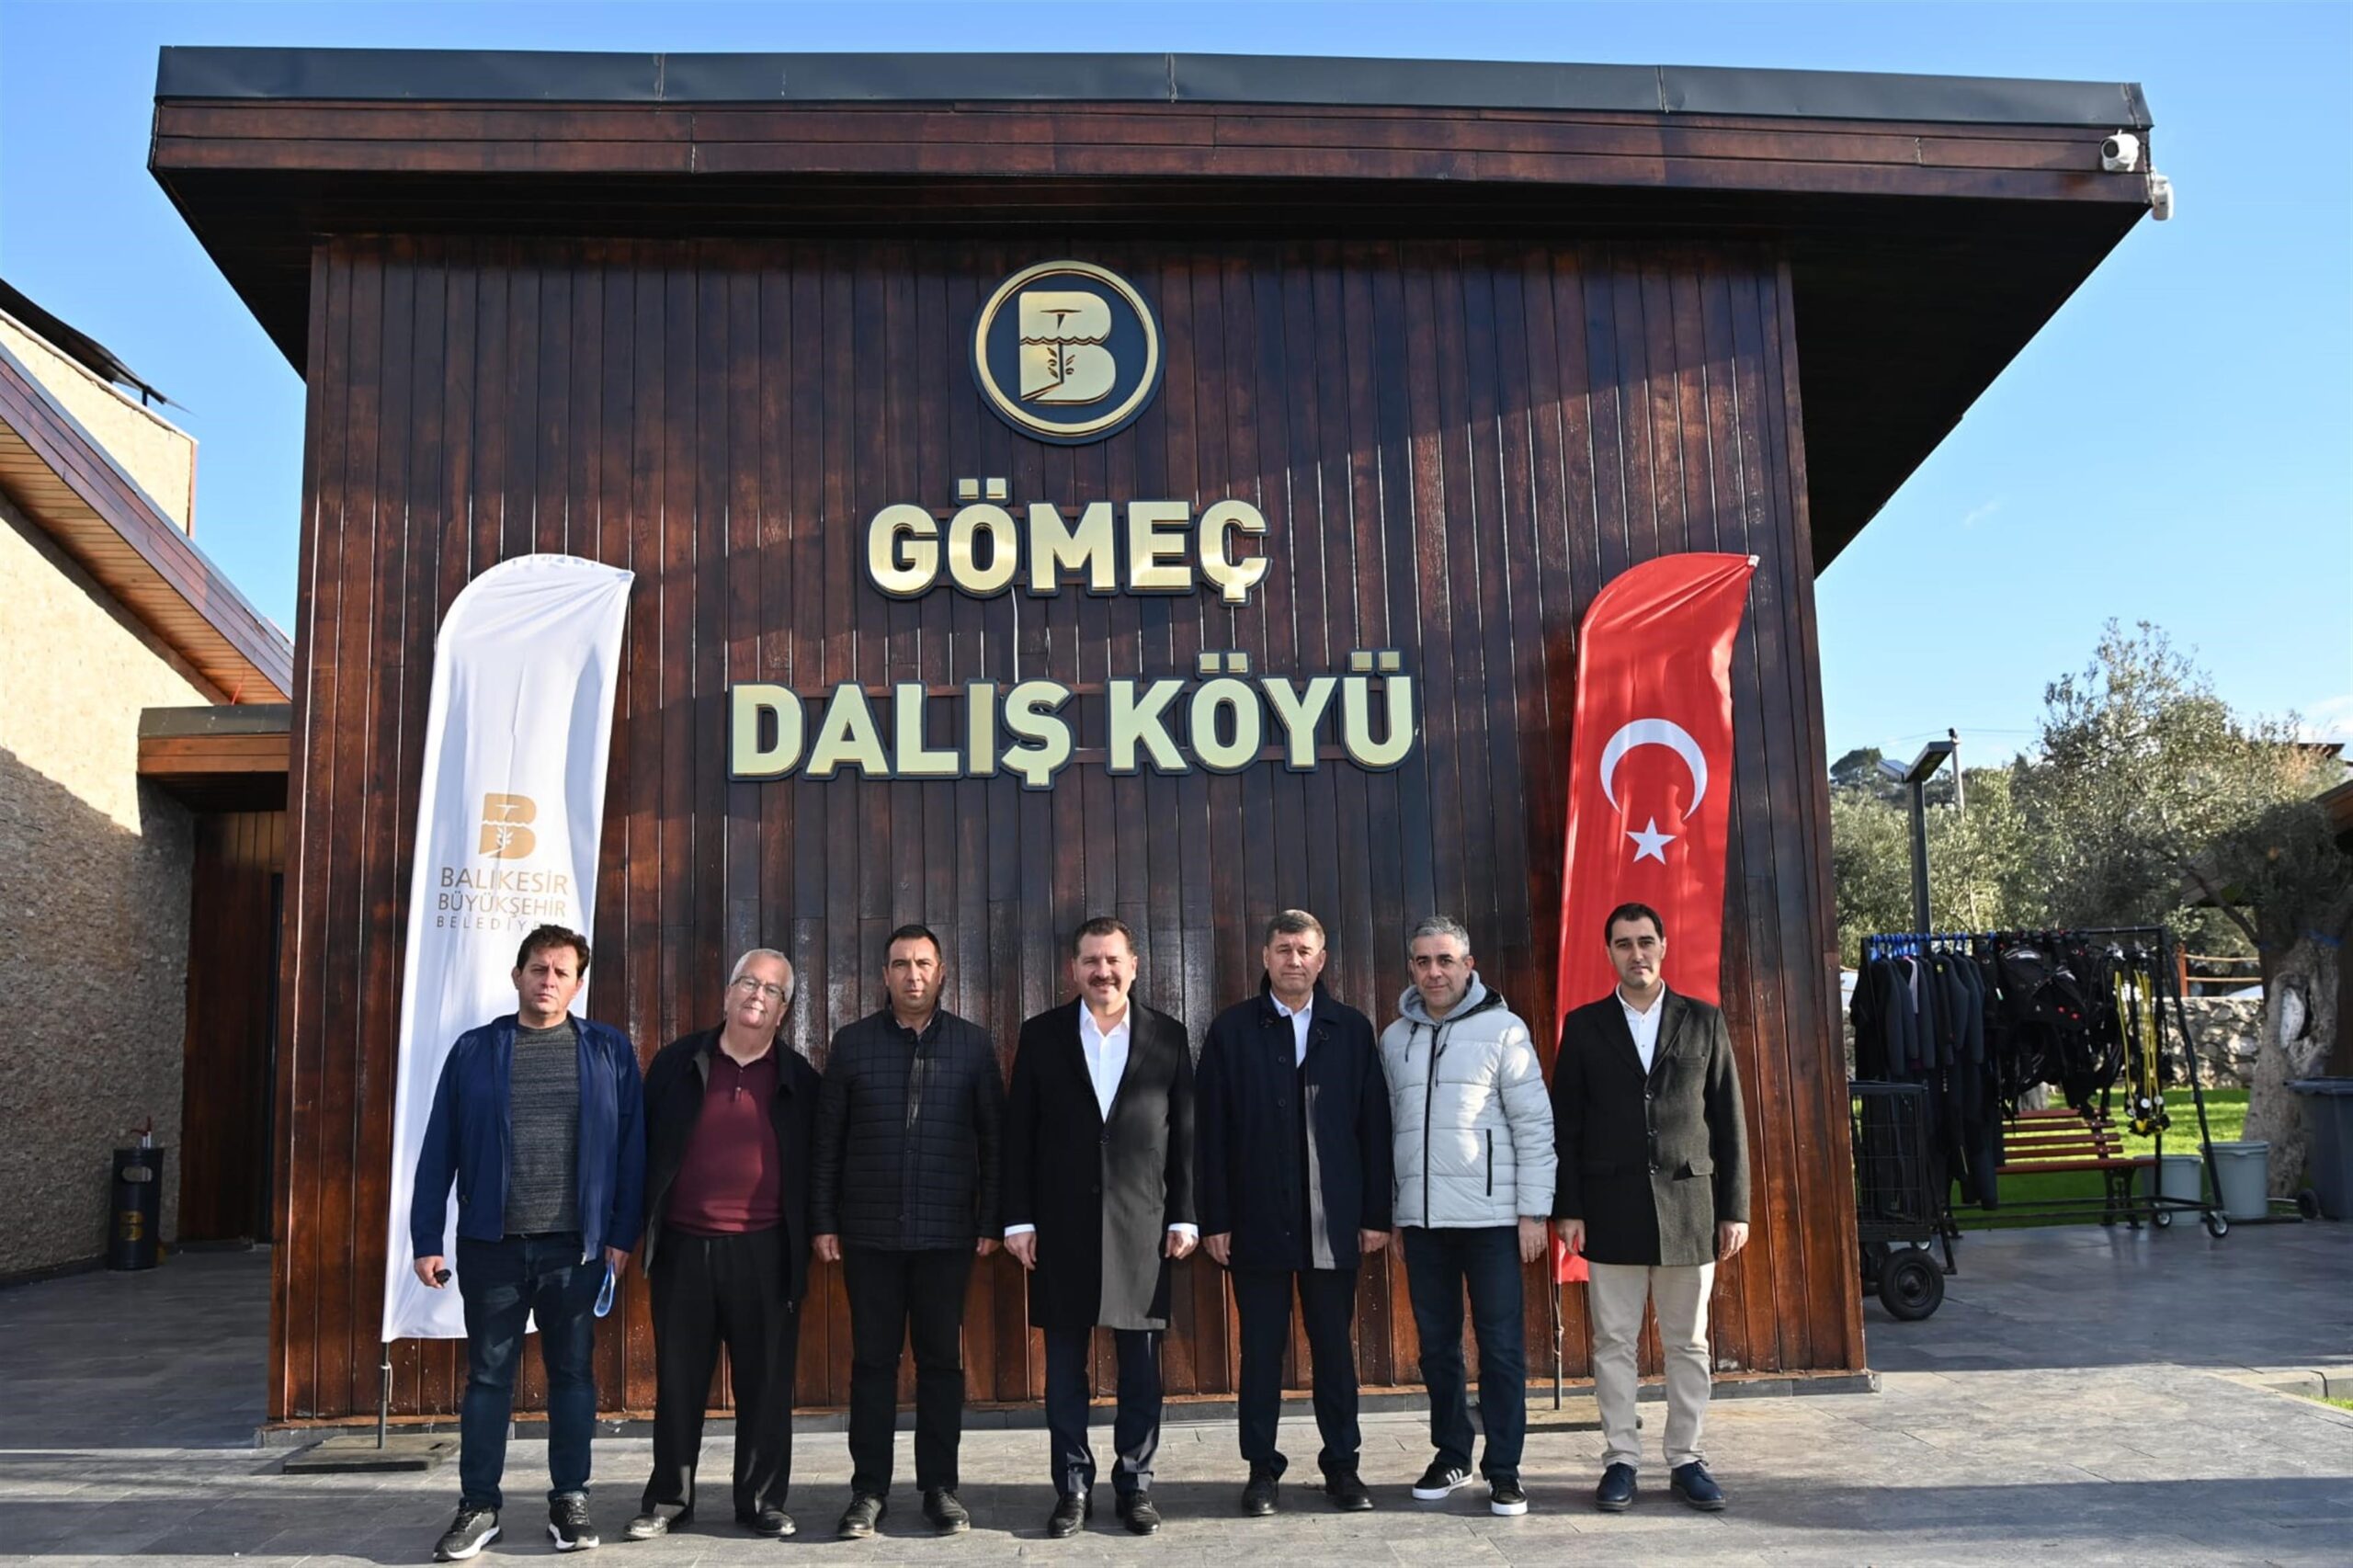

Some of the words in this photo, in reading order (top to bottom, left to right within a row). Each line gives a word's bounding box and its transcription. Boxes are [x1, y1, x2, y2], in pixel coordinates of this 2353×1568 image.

[867, 477, 1270, 604] GÖMEÇ
[732, 679, 1074, 787] DALIŞ
[1108, 650, 1415, 770] KÖYÜ
[438, 891, 566, 918] BÜYÜKŞEHİR
[440, 867, 570, 895] BALIKESİR
